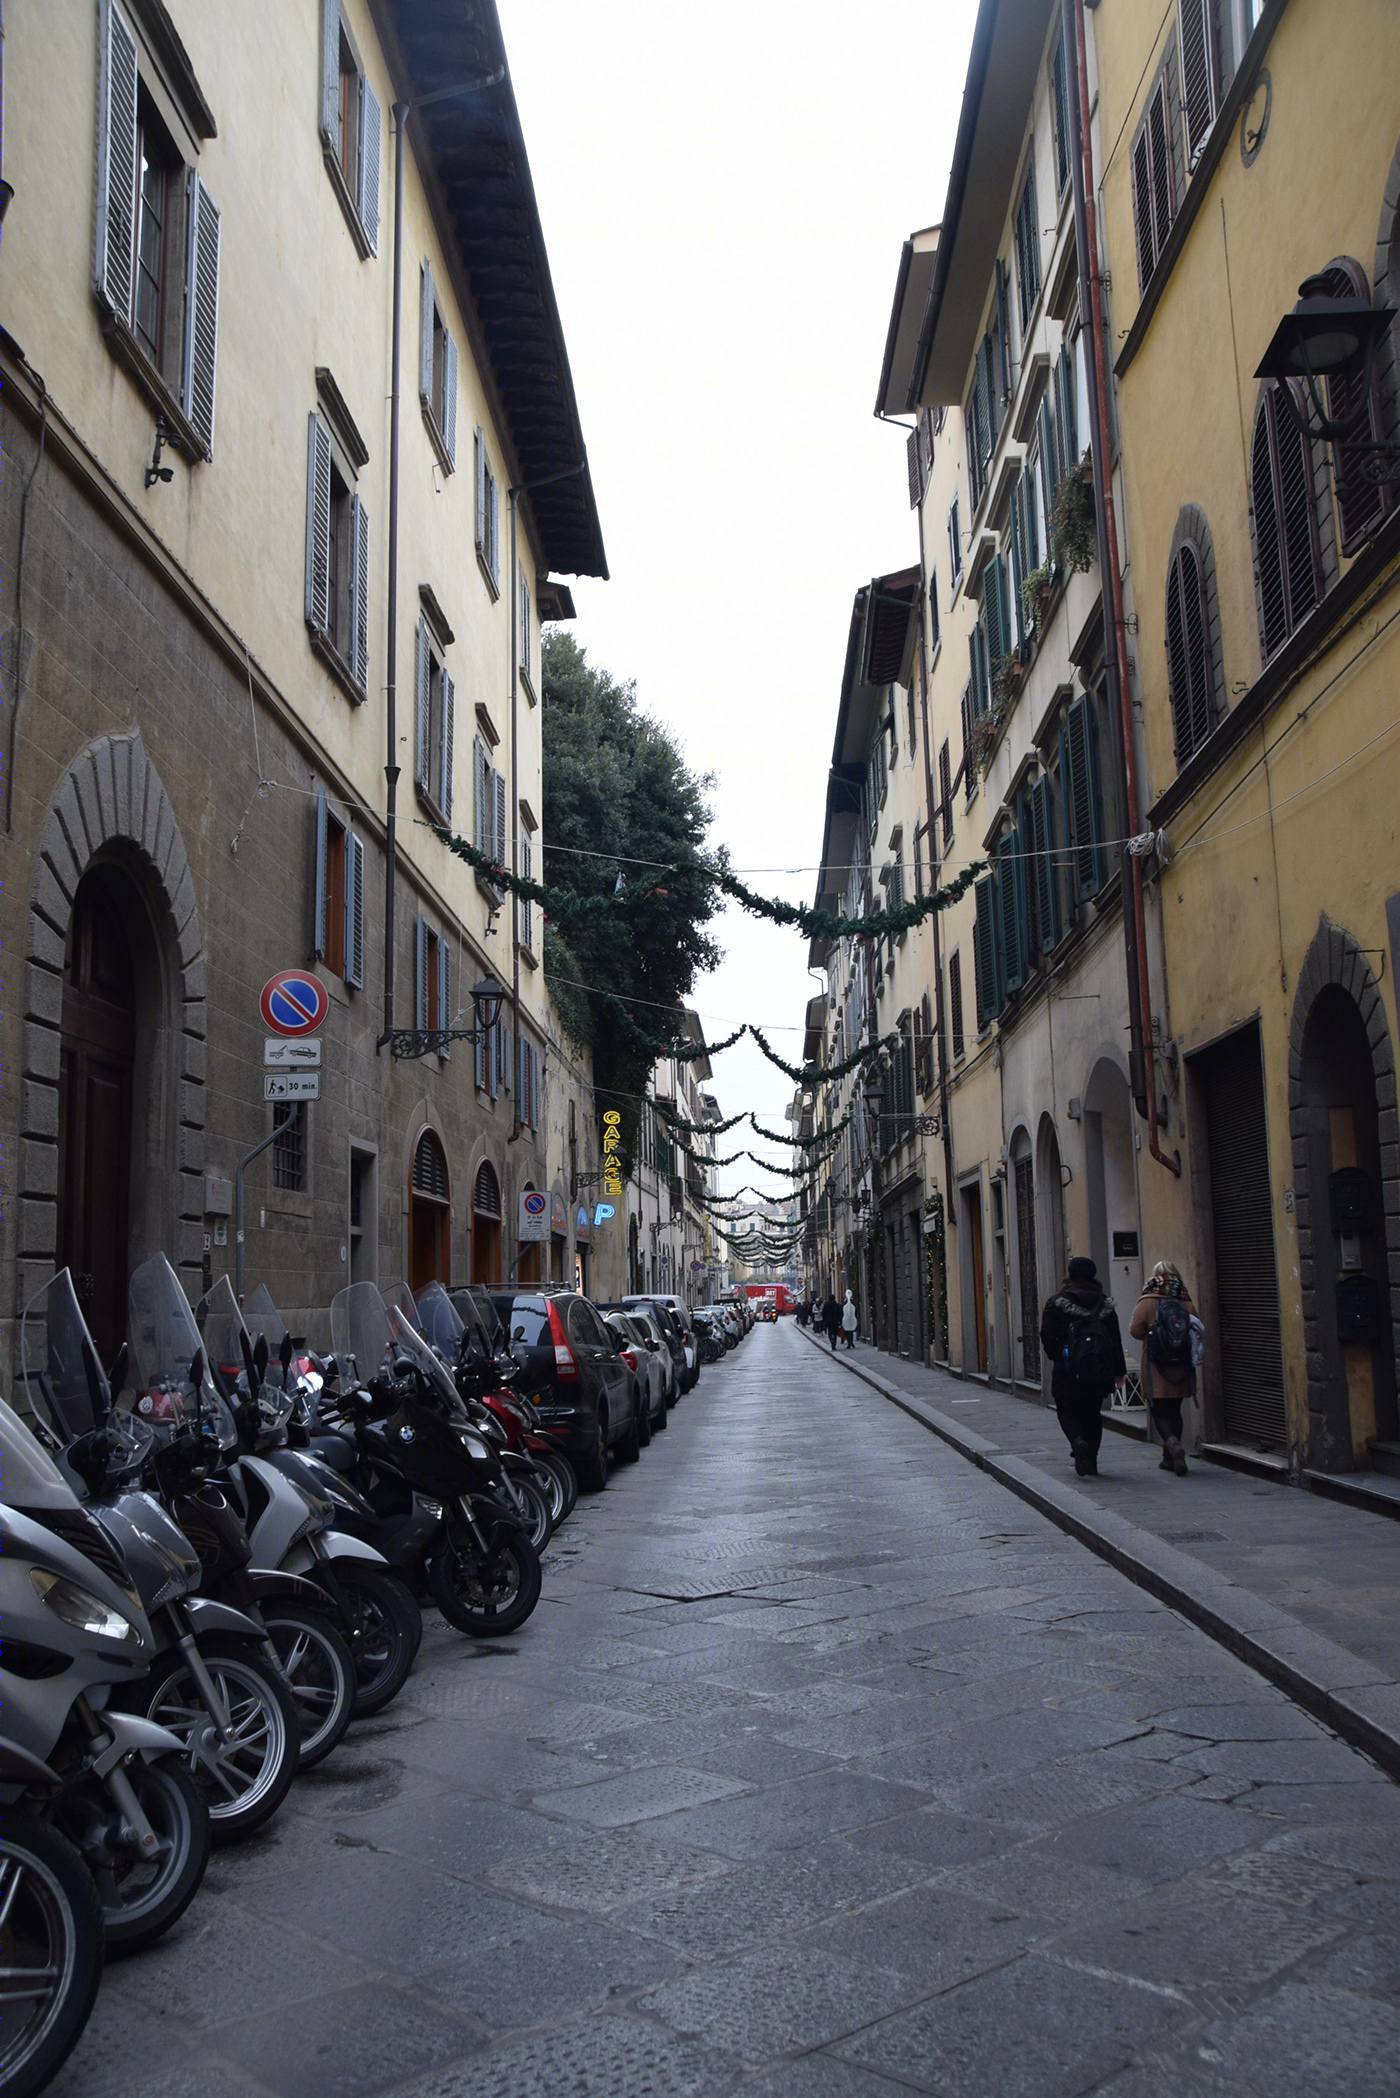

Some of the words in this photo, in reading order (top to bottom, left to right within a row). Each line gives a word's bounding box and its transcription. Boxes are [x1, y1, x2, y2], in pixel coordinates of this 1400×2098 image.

[288, 1082, 299, 1091] 30
[301, 1081, 318, 1090] min.
[603, 1110, 622, 1196] GARAGE
[594, 1202, 615, 1226] P
